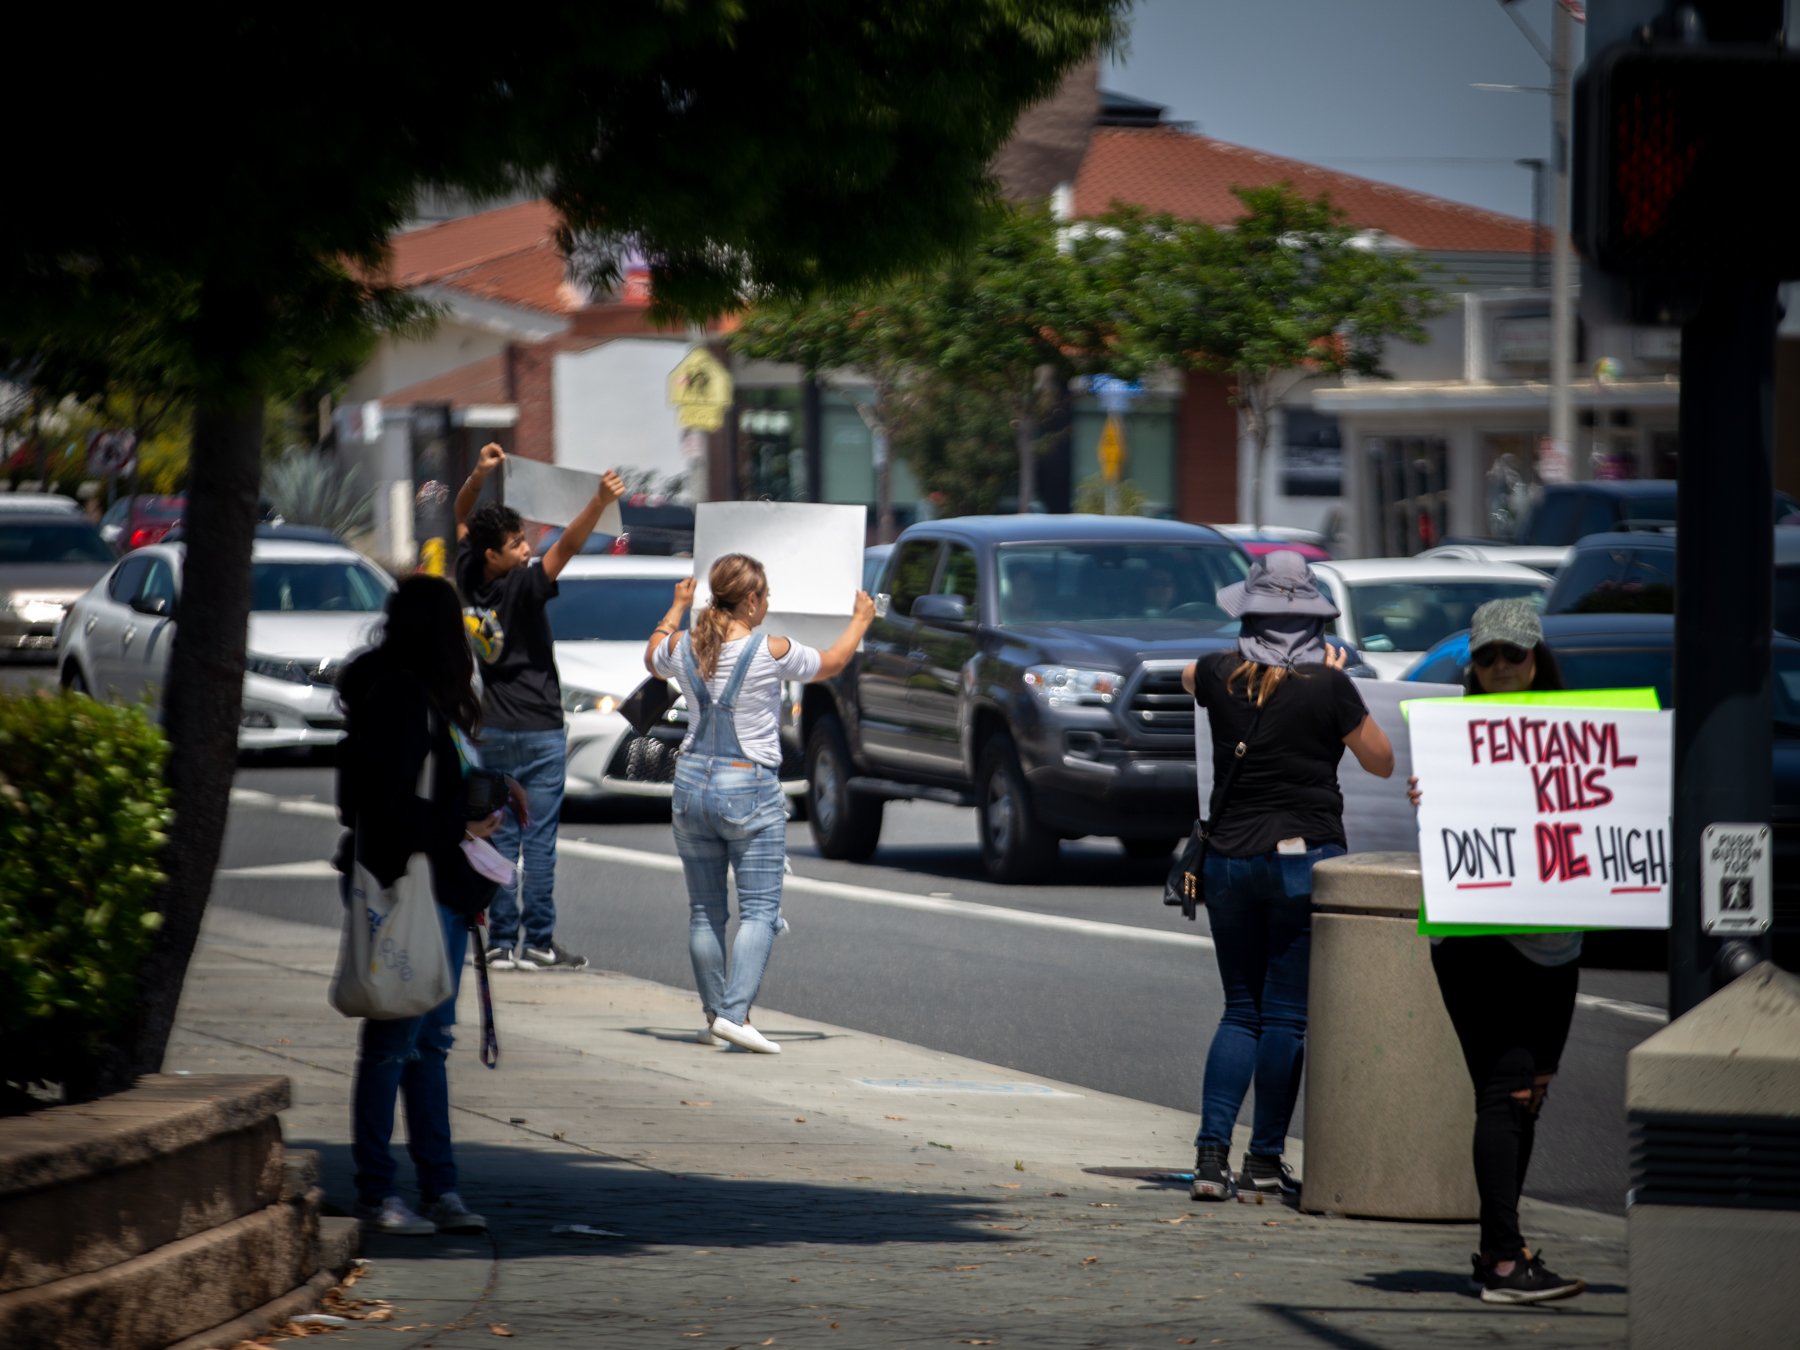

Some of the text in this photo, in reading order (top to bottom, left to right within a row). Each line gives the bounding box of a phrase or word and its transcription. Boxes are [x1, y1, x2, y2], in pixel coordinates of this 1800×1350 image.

[1468, 717, 1638, 768] FENTANYL
[1531, 764, 1614, 814] KILLS
[1441, 822, 1668, 886] DONT DIE HIGH
[1711, 848, 1761, 861] BUTTON
[1719, 834, 1754, 847] PUSH
[1725, 861, 1749, 873] FOR
